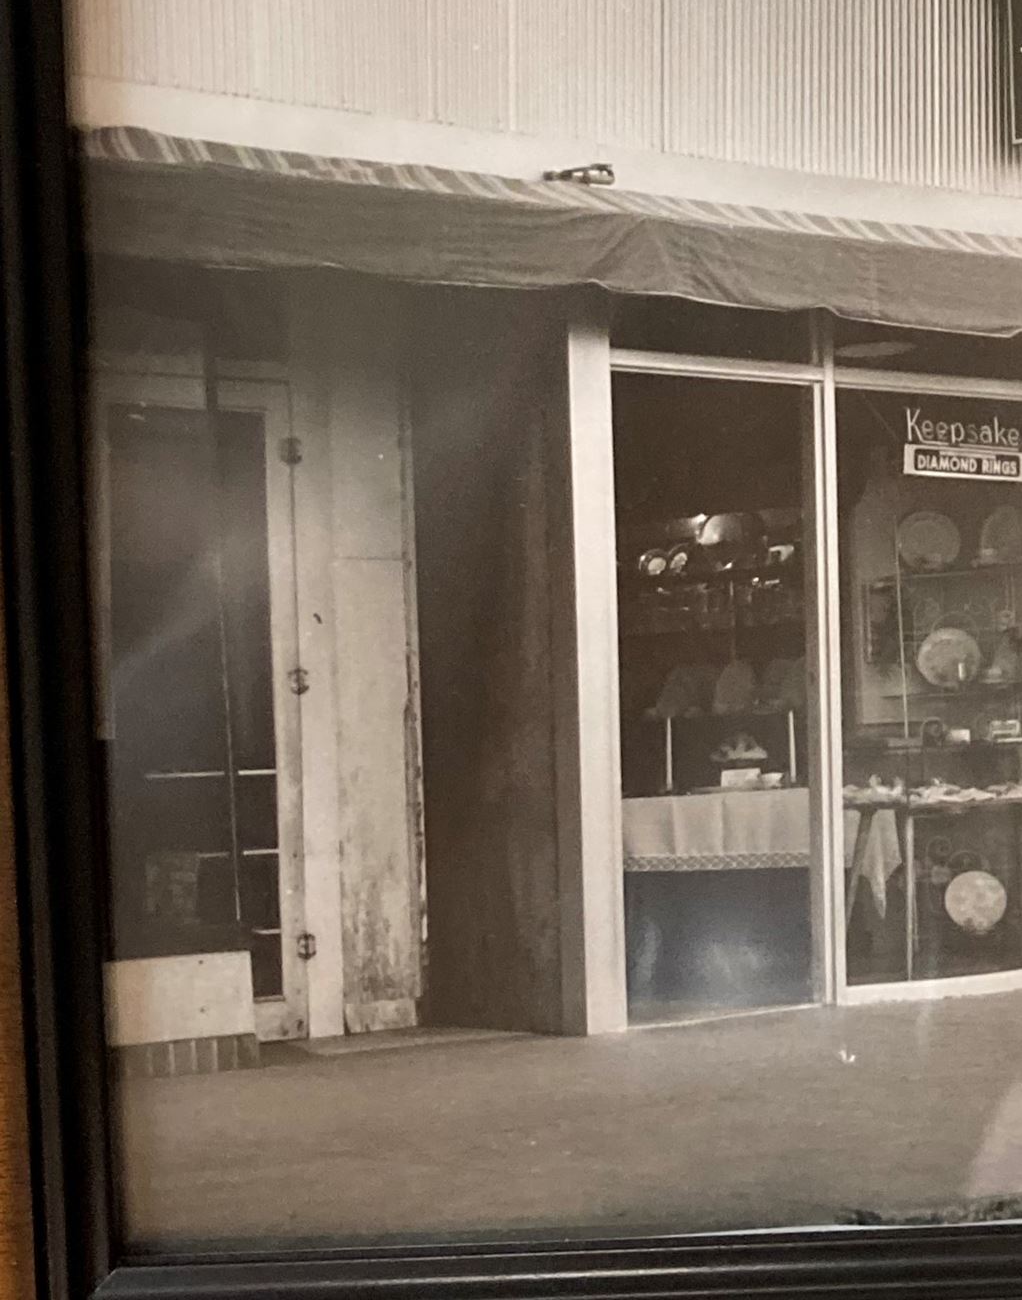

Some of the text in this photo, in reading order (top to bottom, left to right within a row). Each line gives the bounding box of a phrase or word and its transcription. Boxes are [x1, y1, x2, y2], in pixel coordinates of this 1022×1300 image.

[905, 407, 1020, 445] Keepsake
[917, 455, 1017, 475] DIAMOND RINGS
